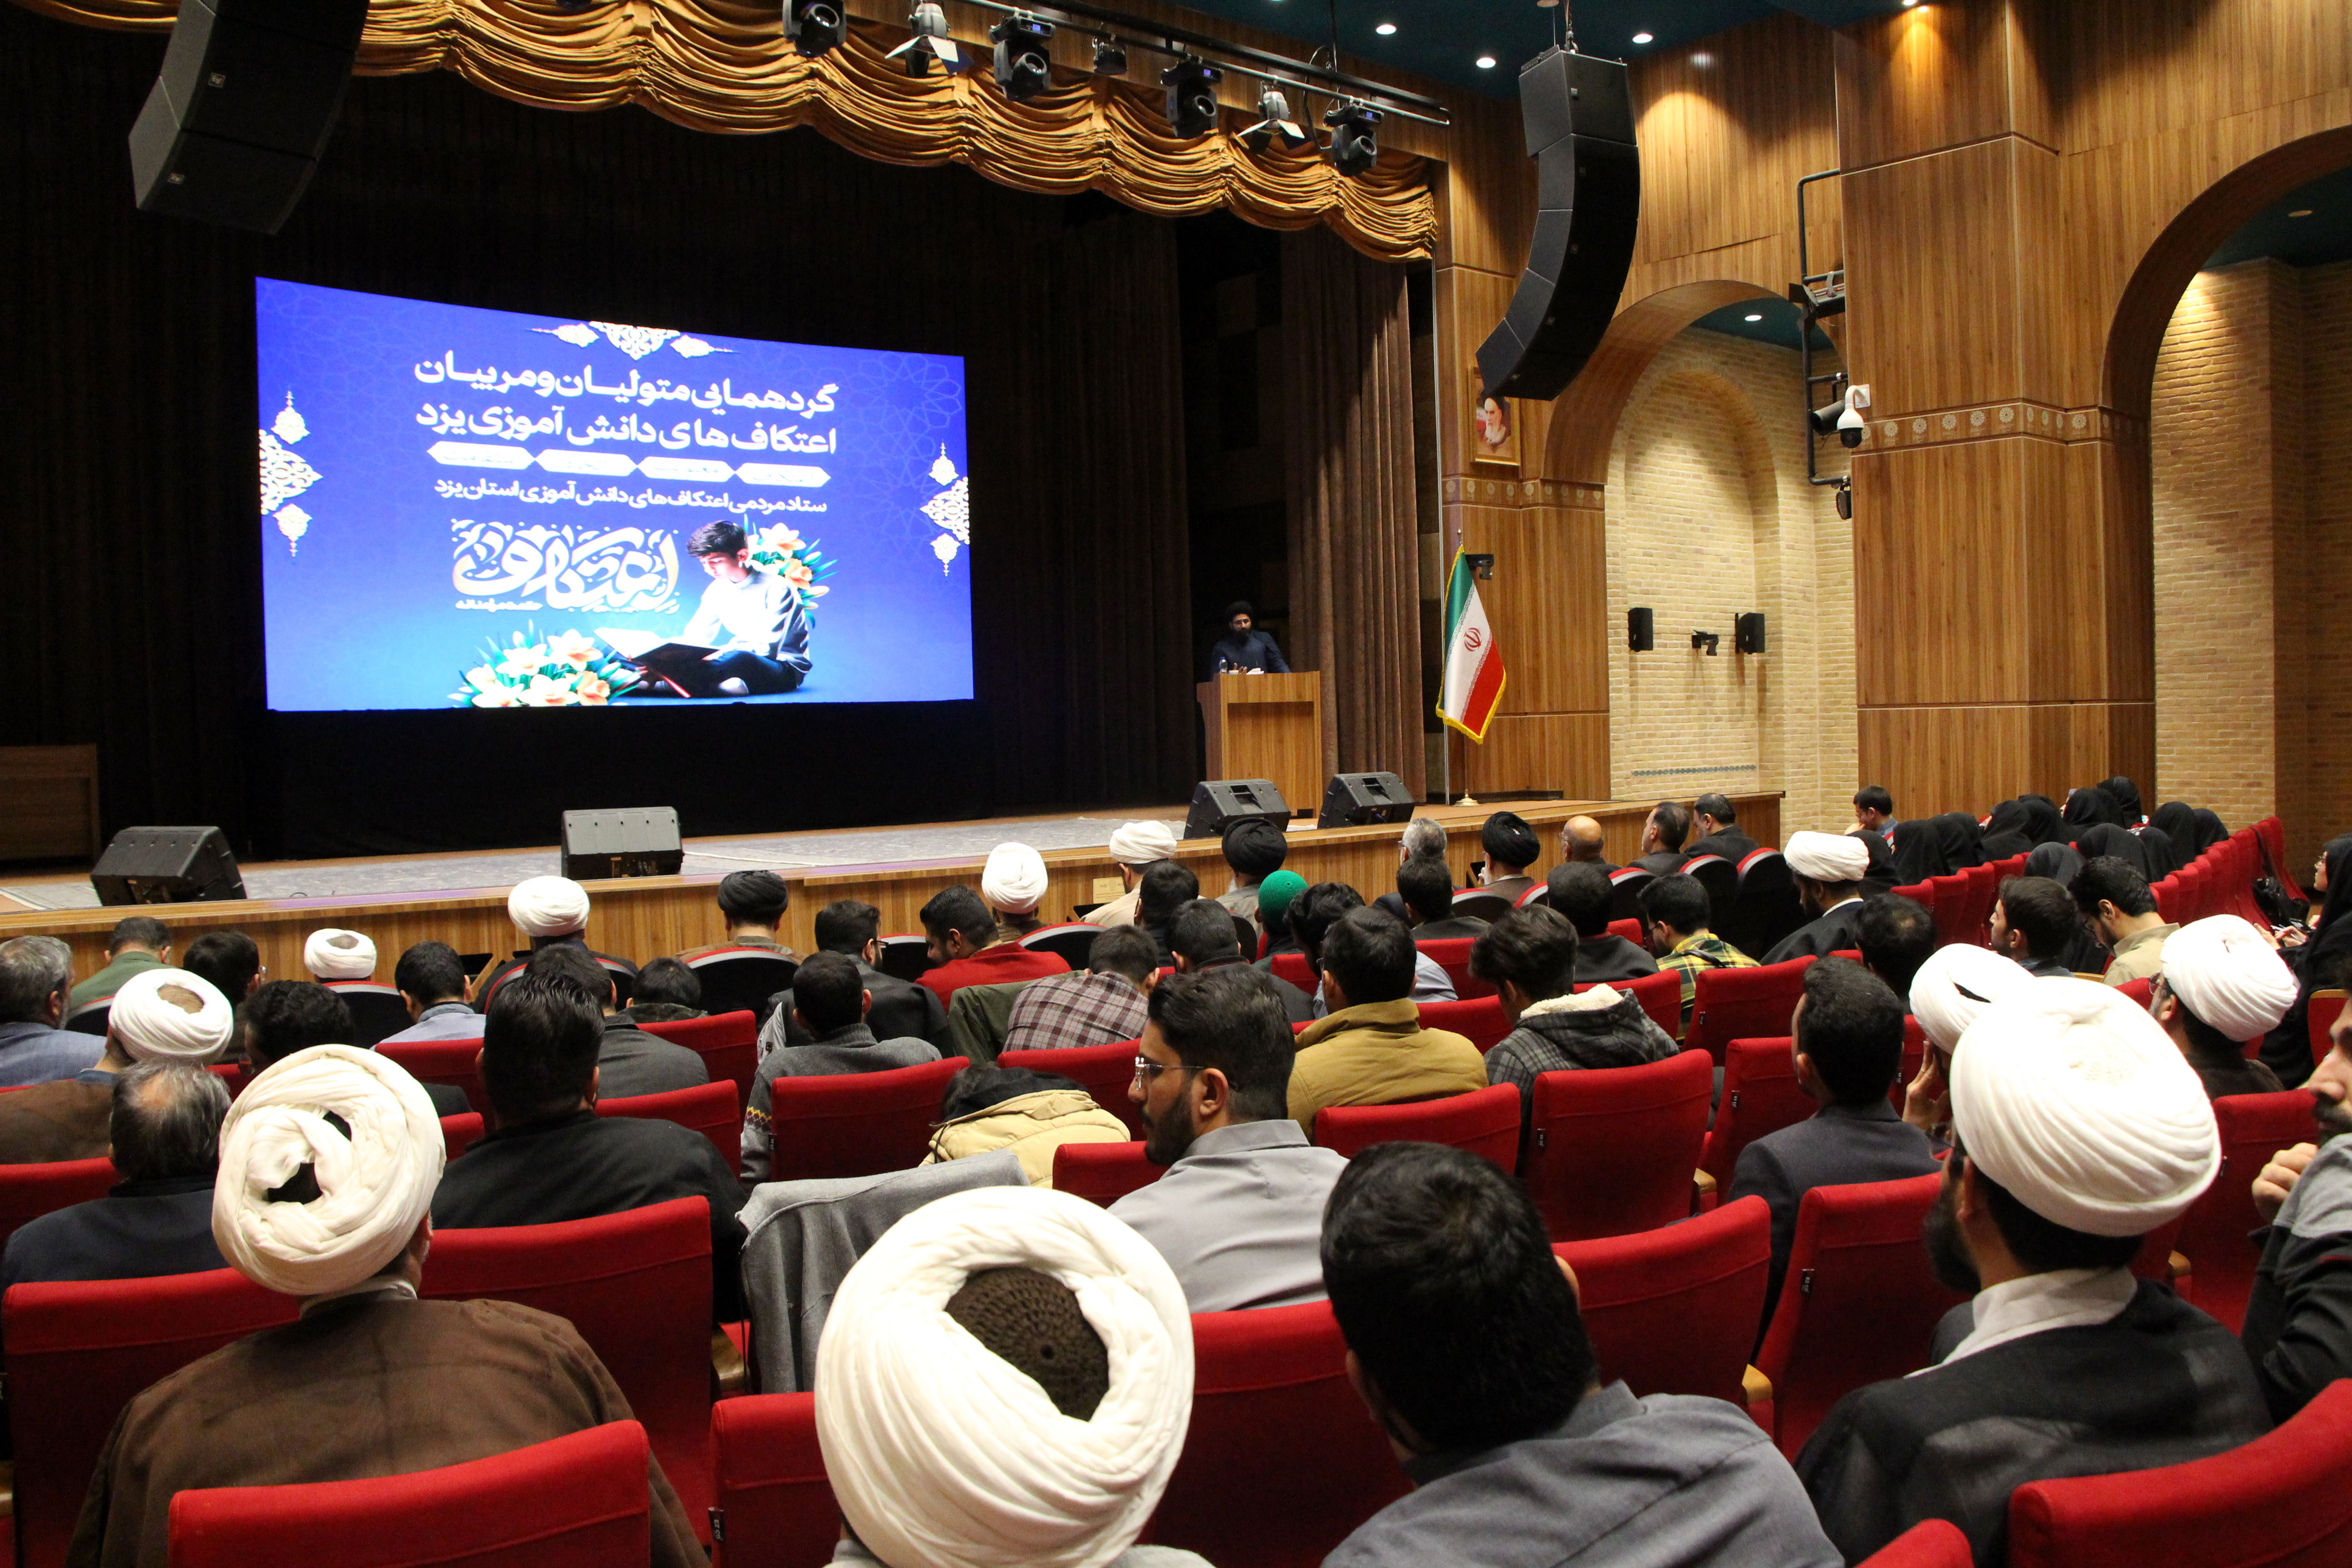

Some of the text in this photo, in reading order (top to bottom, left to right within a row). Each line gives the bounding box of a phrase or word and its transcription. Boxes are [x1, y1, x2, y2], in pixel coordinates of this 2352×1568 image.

[415, 350, 839, 419] گردهمایی متولیان و مربیان
[416, 403, 836, 454] اعتکاف های دانش آموزی یزد
[434, 478, 827, 515] ستاد مردمی اعتکاف های دانش آموزی استان یزد
